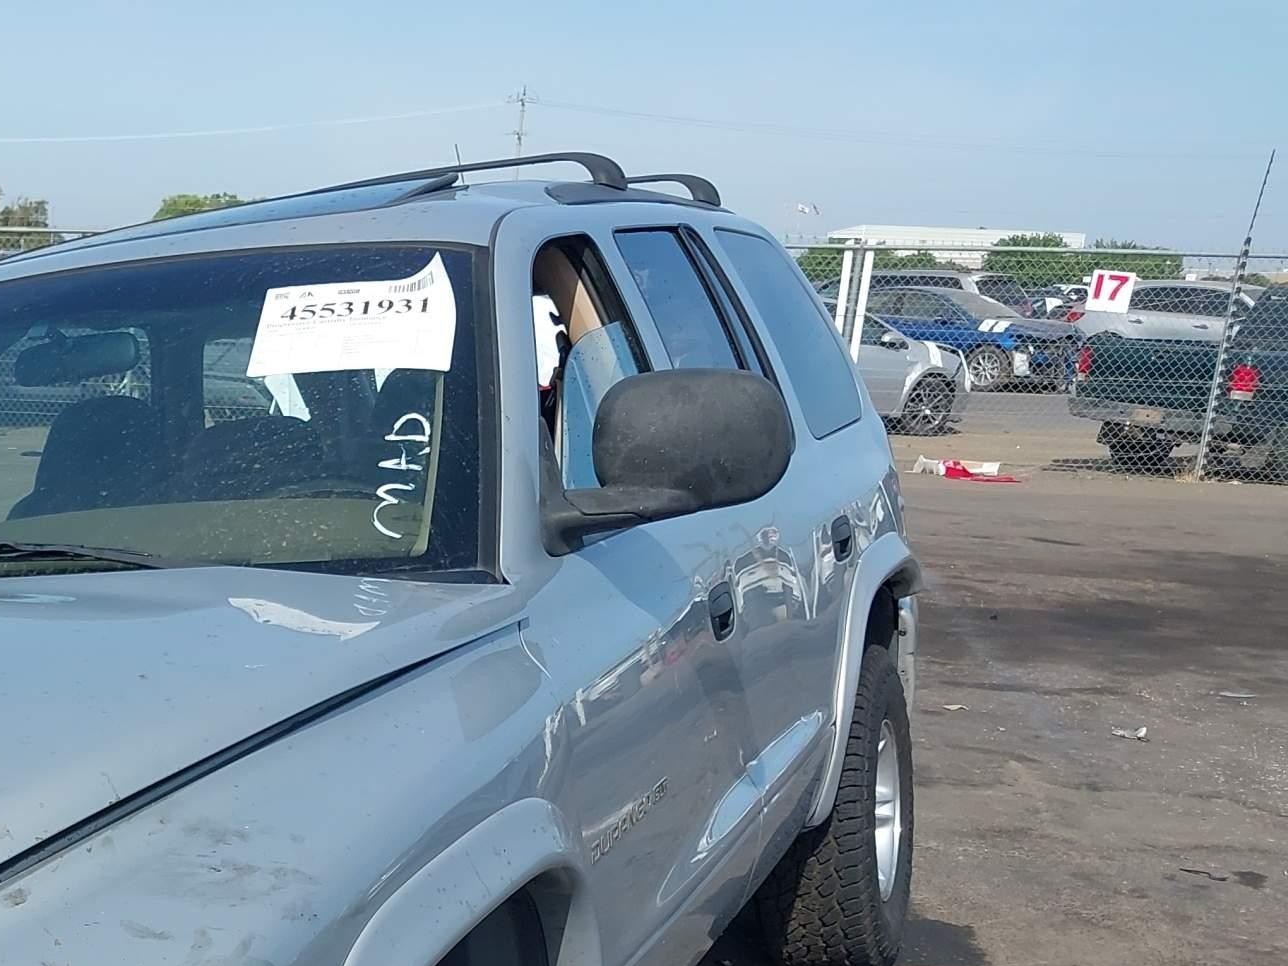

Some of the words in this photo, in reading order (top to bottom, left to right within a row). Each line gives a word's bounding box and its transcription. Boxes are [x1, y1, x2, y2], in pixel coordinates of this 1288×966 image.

[1093, 274, 1129, 301] 17
[280, 296, 431, 321] 45531931
[373, 412, 432, 539] MAD
